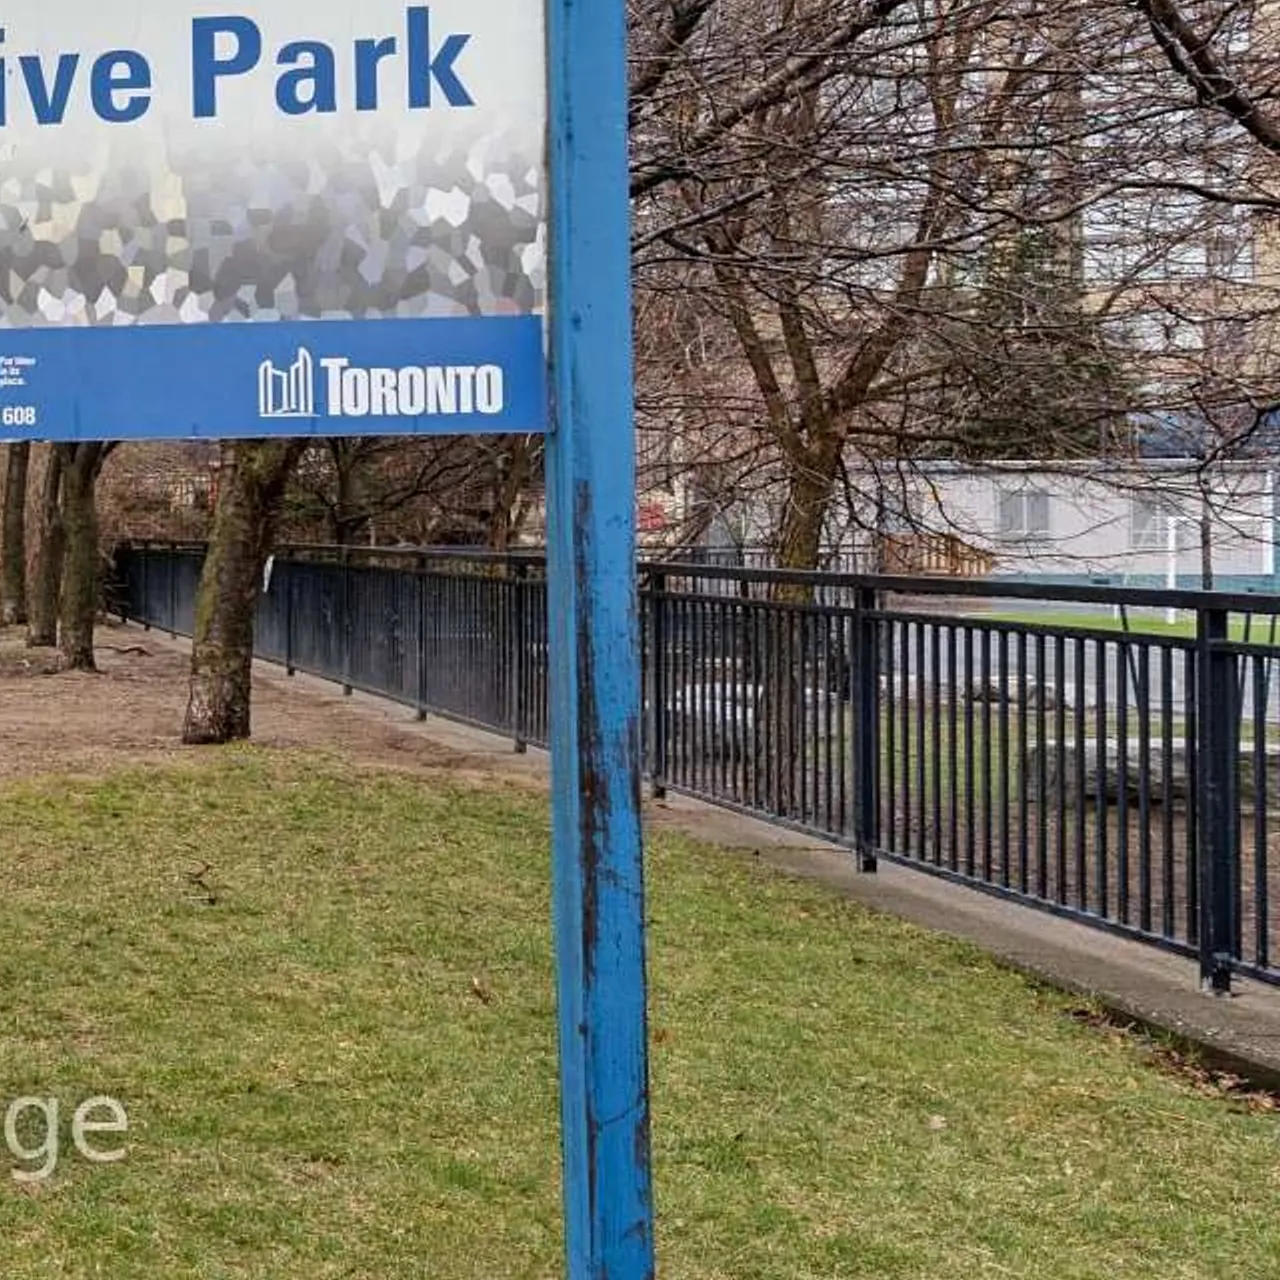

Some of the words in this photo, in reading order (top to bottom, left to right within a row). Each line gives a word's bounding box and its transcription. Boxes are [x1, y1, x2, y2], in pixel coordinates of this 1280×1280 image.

[191, 7, 473, 118] Park
[2, 407, 36, 425] 608
[320, 357, 504, 416] TORONTO
